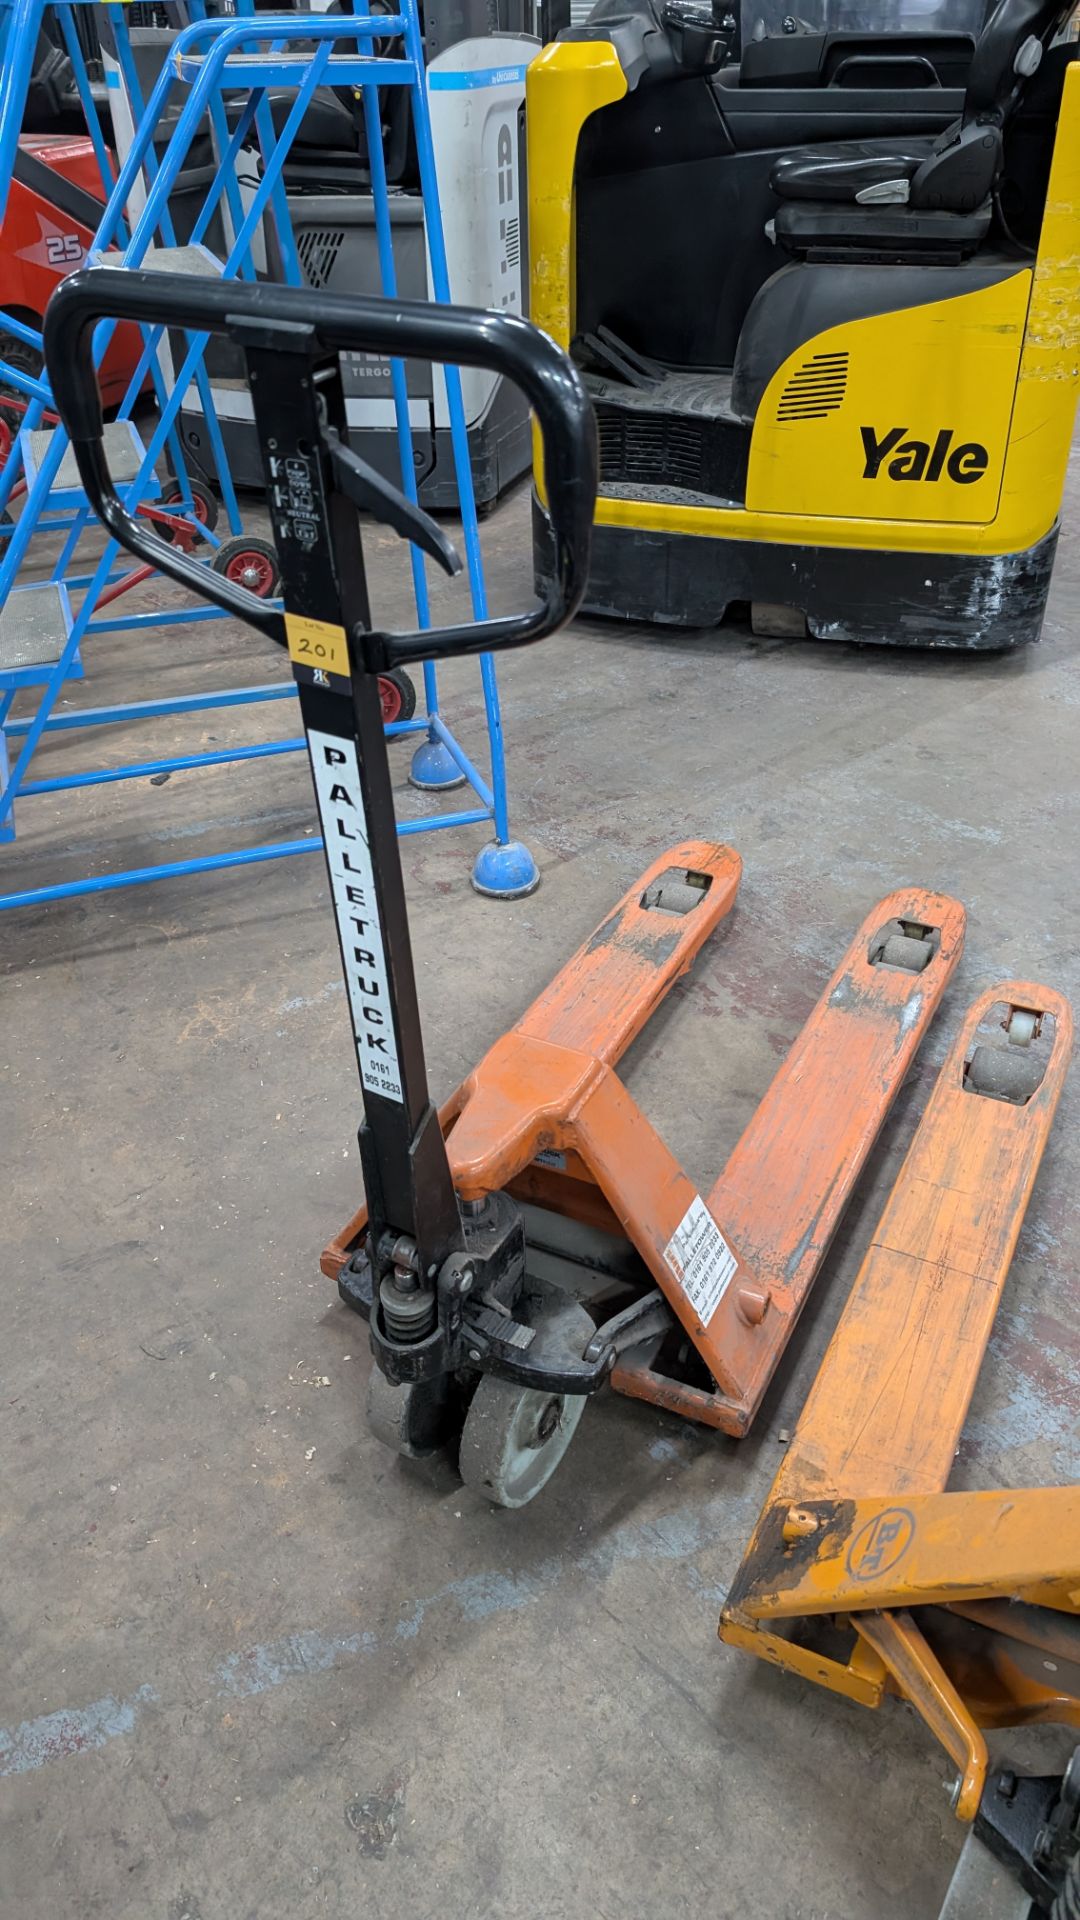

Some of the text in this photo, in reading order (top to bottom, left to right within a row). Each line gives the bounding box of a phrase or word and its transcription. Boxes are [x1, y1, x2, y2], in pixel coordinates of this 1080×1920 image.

[45, 234, 83, 264] 25
[351, 367, 391, 377] TERGO
[859, 426, 989, 485] Yale
[286, 509, 321, 521] NEUTRAL
[298, 638, 335, 660] 201
[323, 745, 389, 1054] PALLETRUCK
[370, 1060, 390, 1075] 0161
[364, 1072, 401, 1094] 905 2233
[692, 1259, 703, 1279] 0161
[699, 1270, 710, 1289] 0161
[859, 1518, 904, 1571] BT
